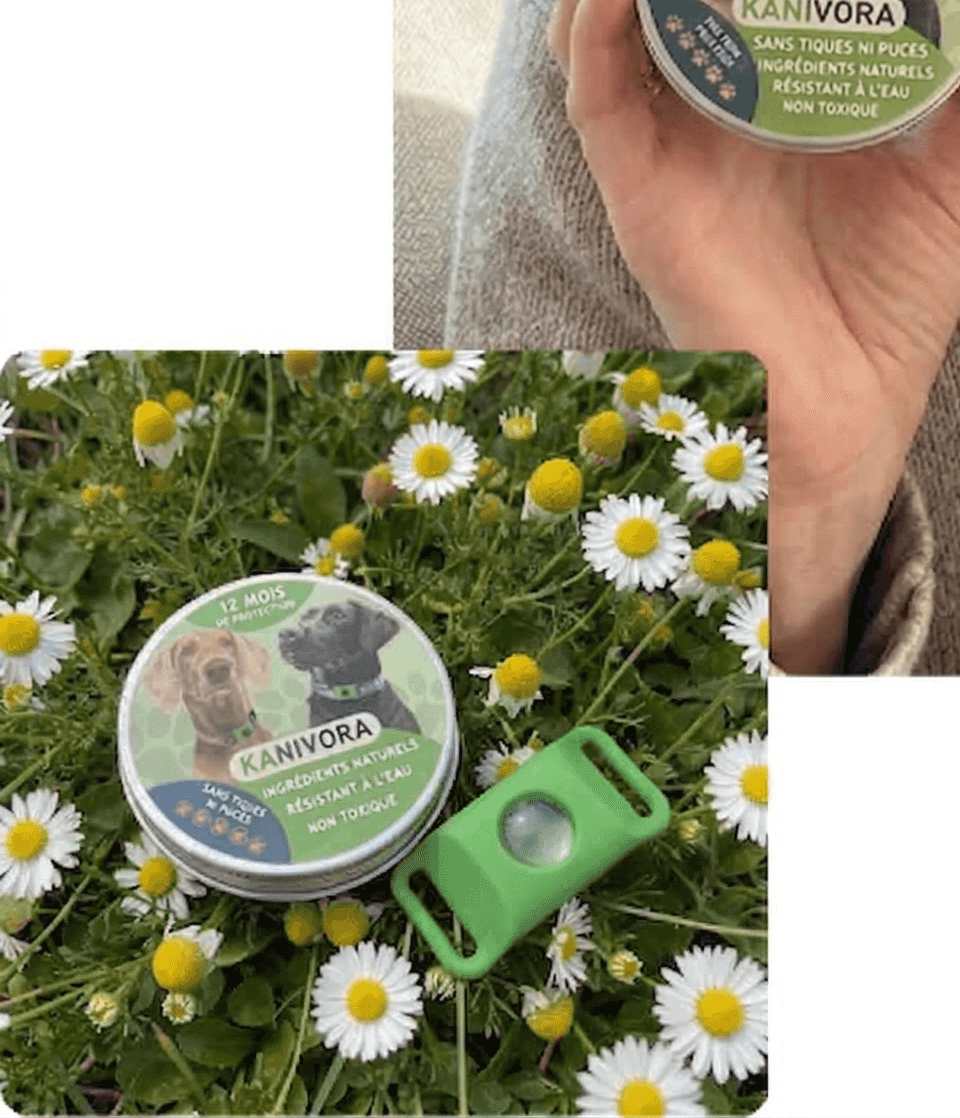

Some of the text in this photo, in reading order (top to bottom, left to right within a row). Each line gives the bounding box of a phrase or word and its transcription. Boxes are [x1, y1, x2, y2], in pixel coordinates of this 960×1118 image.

[753, 35, 794, 52] SANS
[800, 37, 853, 55] TIQUES
[858, 41, 874, 55] NI
[878, 41, 928, 59] PUCES
[757, 56, 935, 80] INGRÉDIENTS NATURELS
[772, 76, 850, 97] RÉSISTANT
[869, 84, 910, 99] L'EAU
[783, 101, 879, 119] NON TOXIQUE
[220, 584, 286, 614] 12 MOIS
[239, 718, 373, 776] KANIVORA
[352, 738, 419, 769] NATURELS
[307, 814, 337, 834] NON
